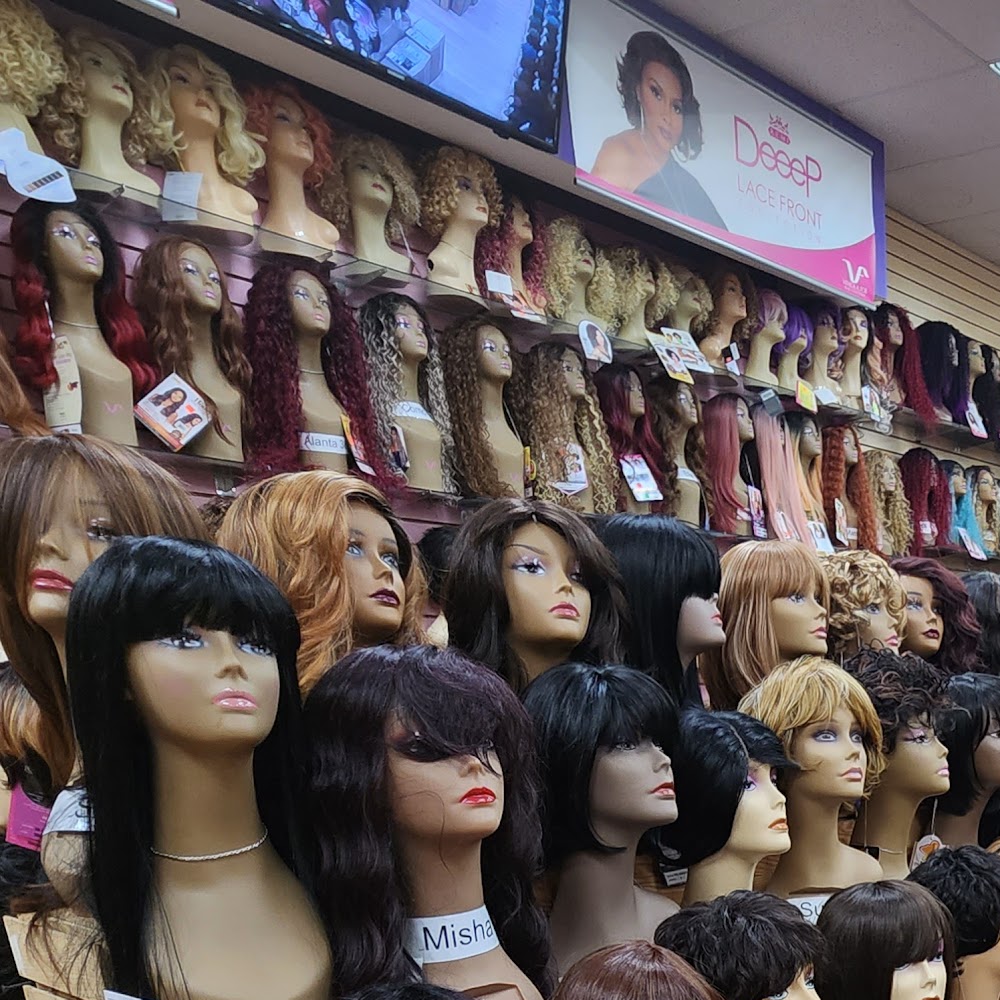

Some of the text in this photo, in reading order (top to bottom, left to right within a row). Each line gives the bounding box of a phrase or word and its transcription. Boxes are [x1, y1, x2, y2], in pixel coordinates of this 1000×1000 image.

[737, 174, 775, 208] LACE
[779, 194, 822, 229] FRONT
[422, 918, 494, 951] Misha
